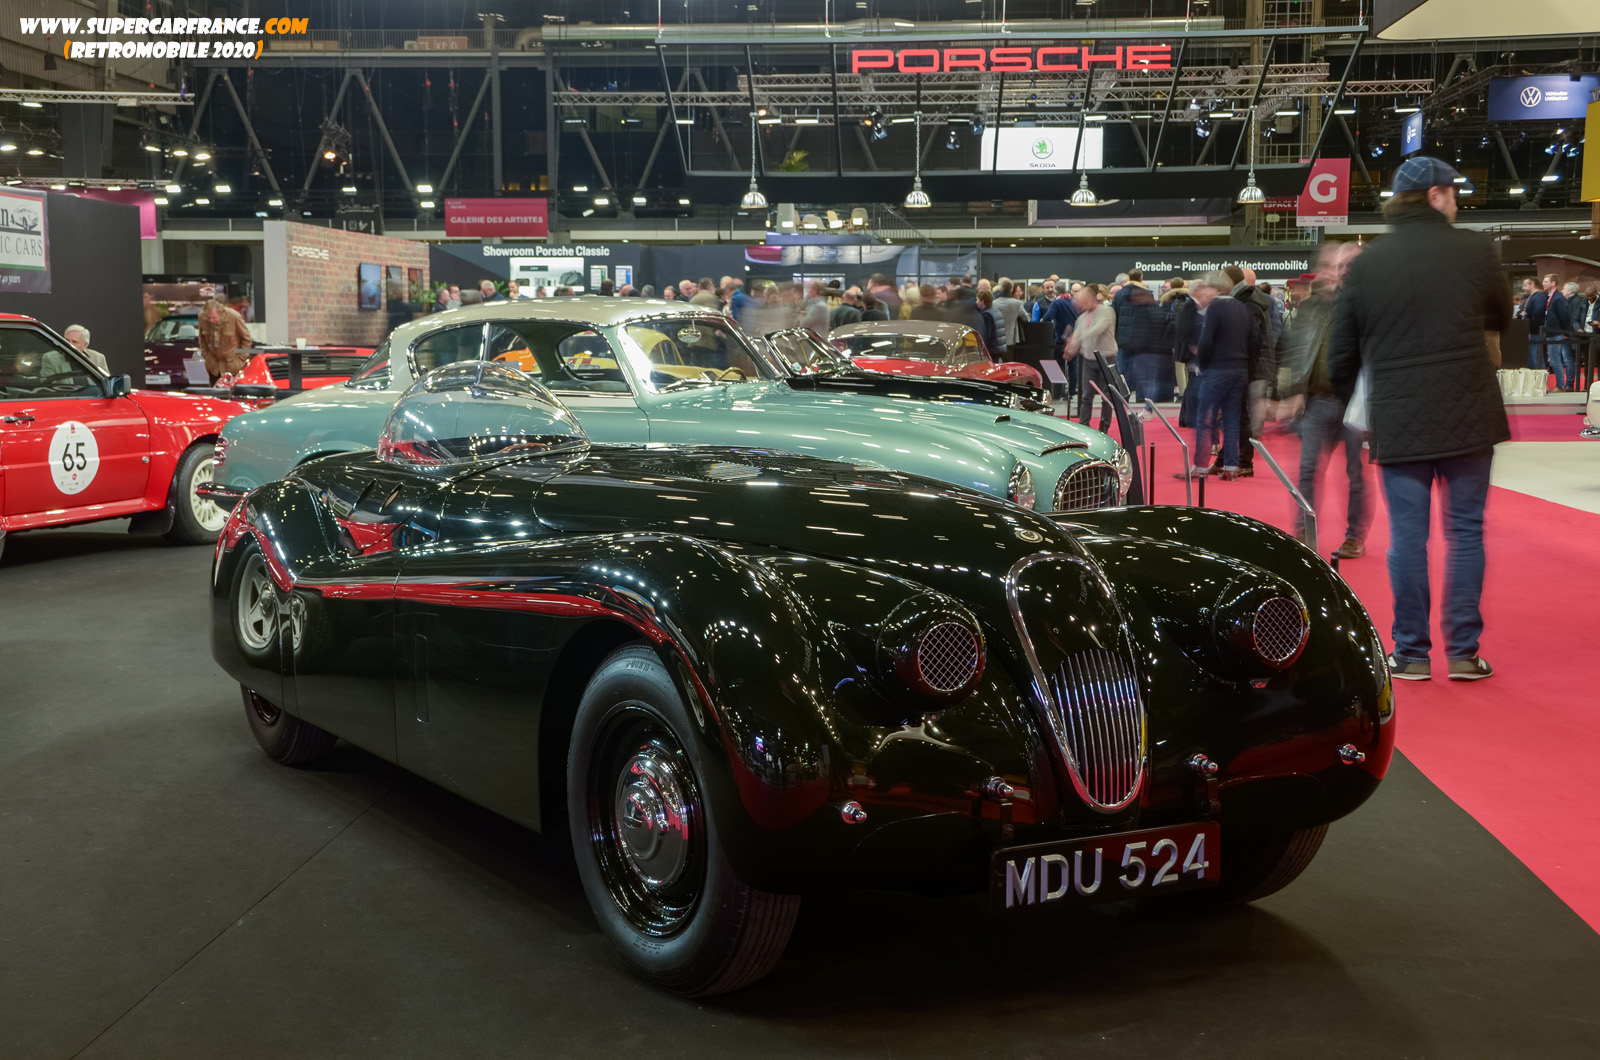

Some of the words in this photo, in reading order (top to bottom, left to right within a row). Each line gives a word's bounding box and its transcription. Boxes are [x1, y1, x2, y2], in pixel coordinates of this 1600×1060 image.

[852, 45, 1172, 73] PORSCHE
[1309, 173, 1337, 203] G
[1264, 200, 1292, 208] ESPACE
[450, 216, 485, 224] GALERIE
[16, 237, 43, 256] CARS
[292, 245, 329, 260] PORSCHE
[483, 245, 534, 257] Showroom
[536, 246, 574, 256] Porsche
[575, 246, 610, 256] Classic
[1135, 261, 1172, 271] Porsche
[1182, 261, 1220, 271] Pionnier
[62, 442, 87, 472] 65
[1006, 848, 1103, 908] MDU
[1119, 833, 1209, 890] 524
